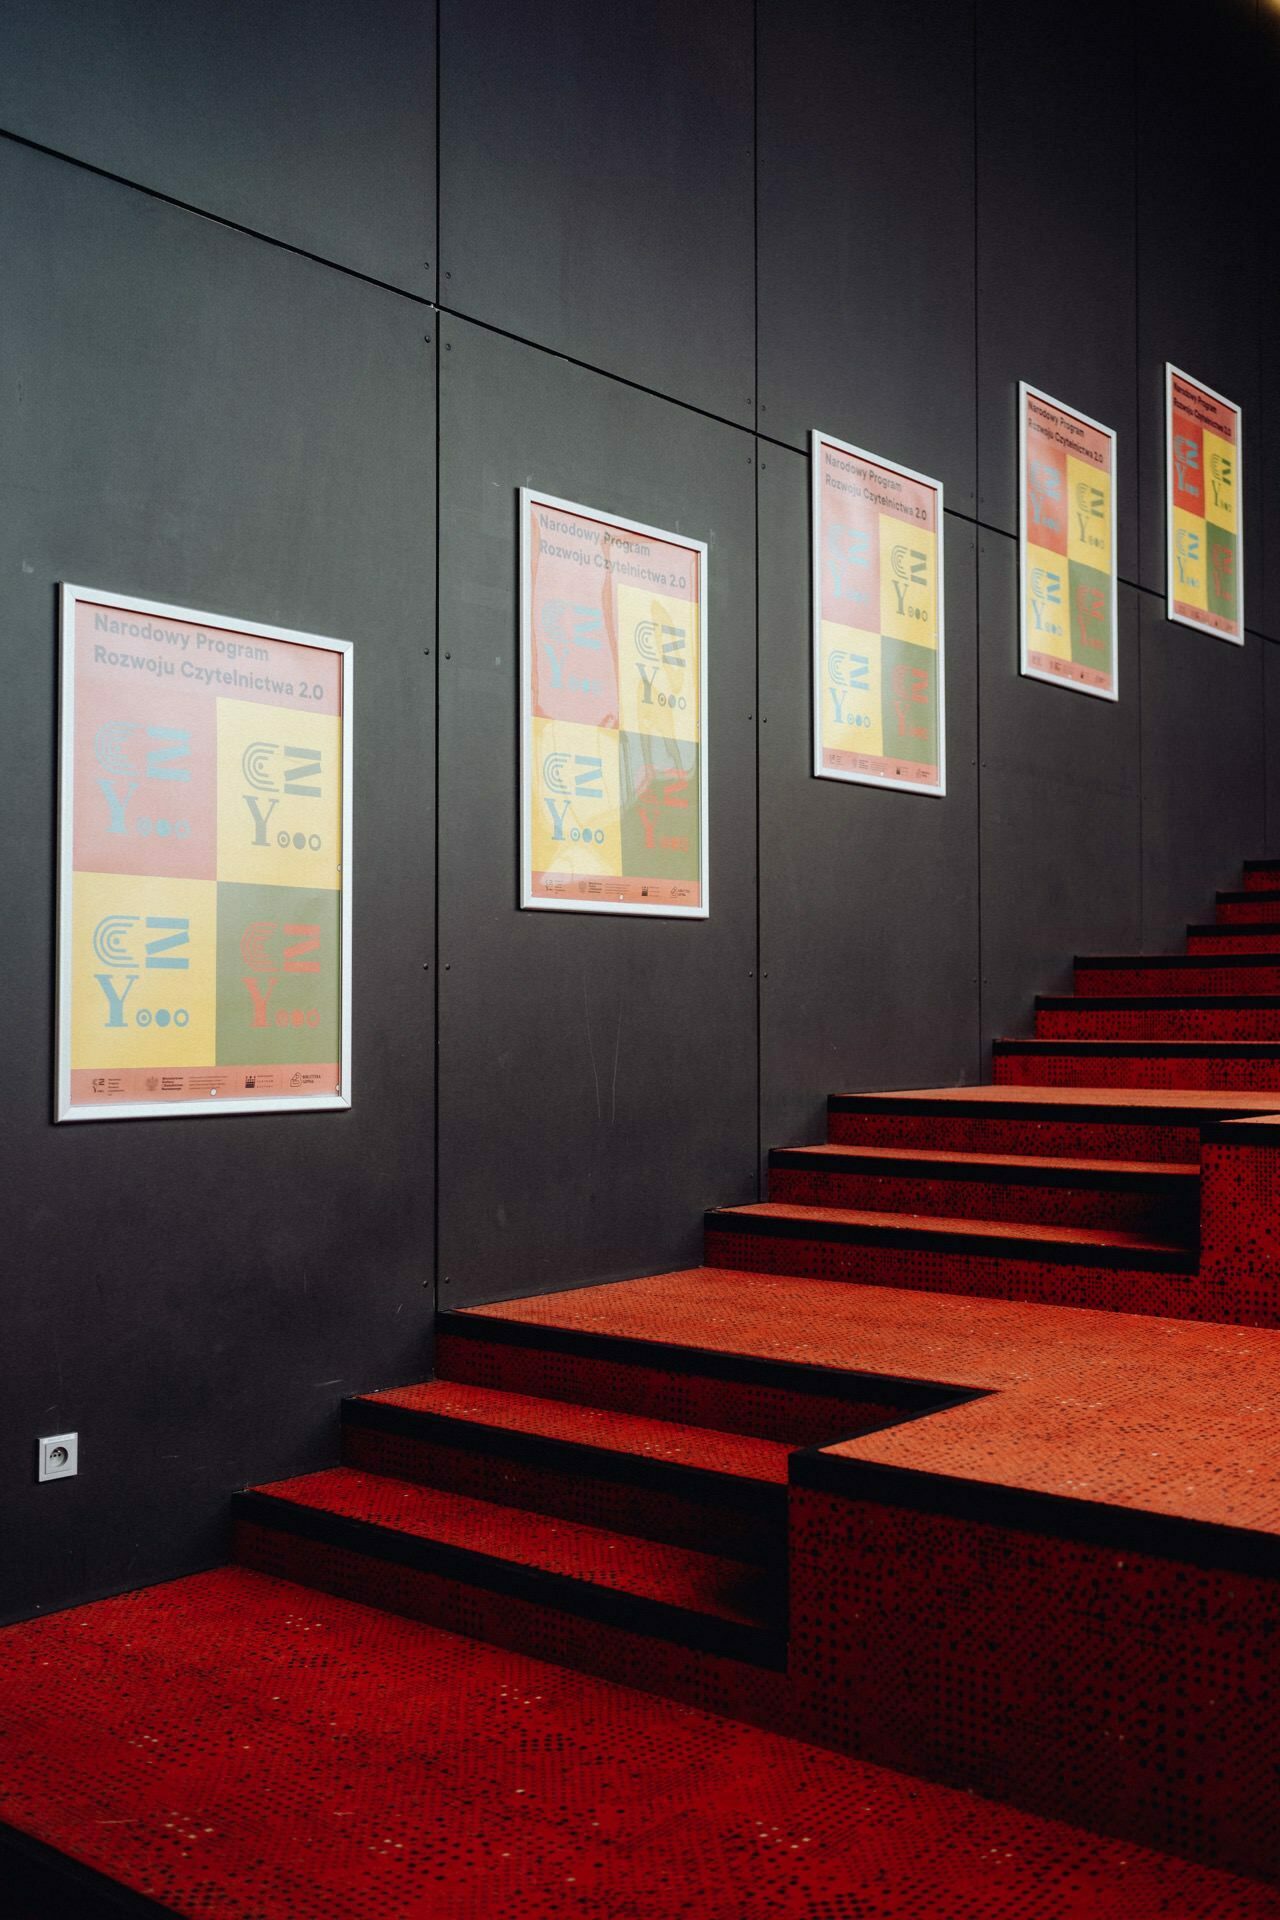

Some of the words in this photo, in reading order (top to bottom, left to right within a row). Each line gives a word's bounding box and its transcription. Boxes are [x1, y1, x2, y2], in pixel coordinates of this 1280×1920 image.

[825, 453, 868, 482] Narodowy
[869, 470, 902, 492] Program
[825, 473, 862, 499] Rozwoju
[863, 488, 914, 517] Czytelnictwa
[915, 507, 927, 521] 2.0
[539, 513, 600, 546] Narodowy
[604, 531, 650, 556] Program
[540, 540, 591, 566] Rozwoju
[594, 554, 667, 585] Czytelnictwa
[670, 574, 687, 589] 2.0
[94, 613, 190, 650] Narodowy
[197, 632, 269, 661] Program
[94, 645, 175, 677] Rozwoju
[181, 661, 294, 695] Czytelnictwa
[299, 682, 324, 700] 2.0
